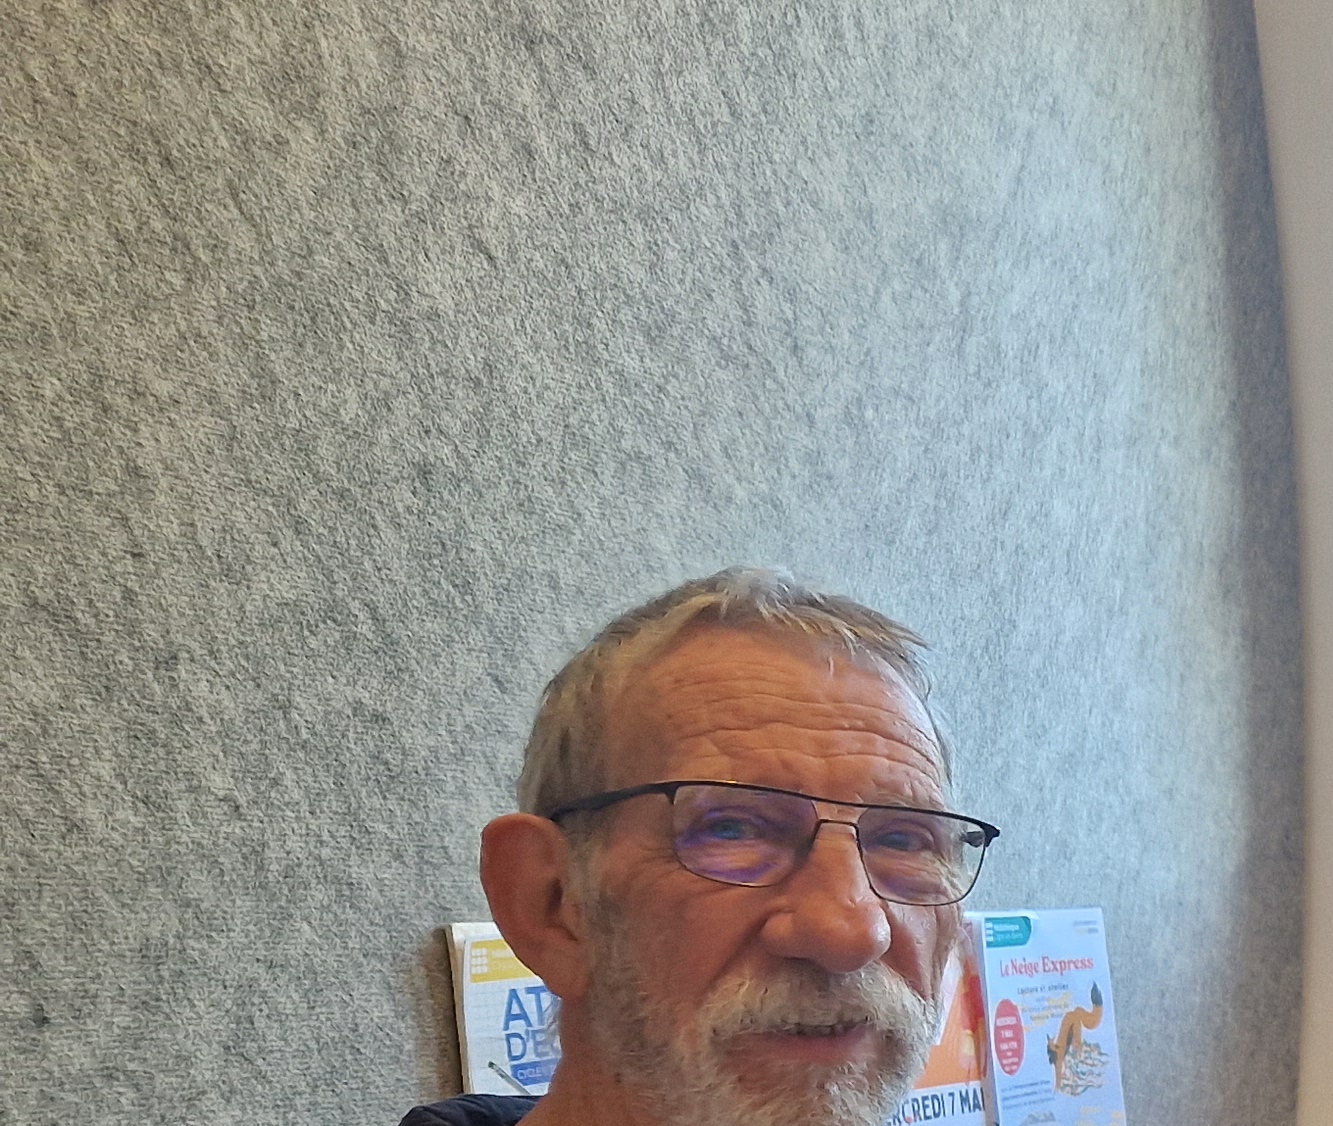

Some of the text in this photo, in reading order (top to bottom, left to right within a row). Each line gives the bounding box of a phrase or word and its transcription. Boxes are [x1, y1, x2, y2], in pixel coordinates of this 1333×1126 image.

[1000, 955, 1094, 977] Le Neige Express
[948, 1091, 955, 1116] 7
[959, 1087, 985, 1114] MAI
